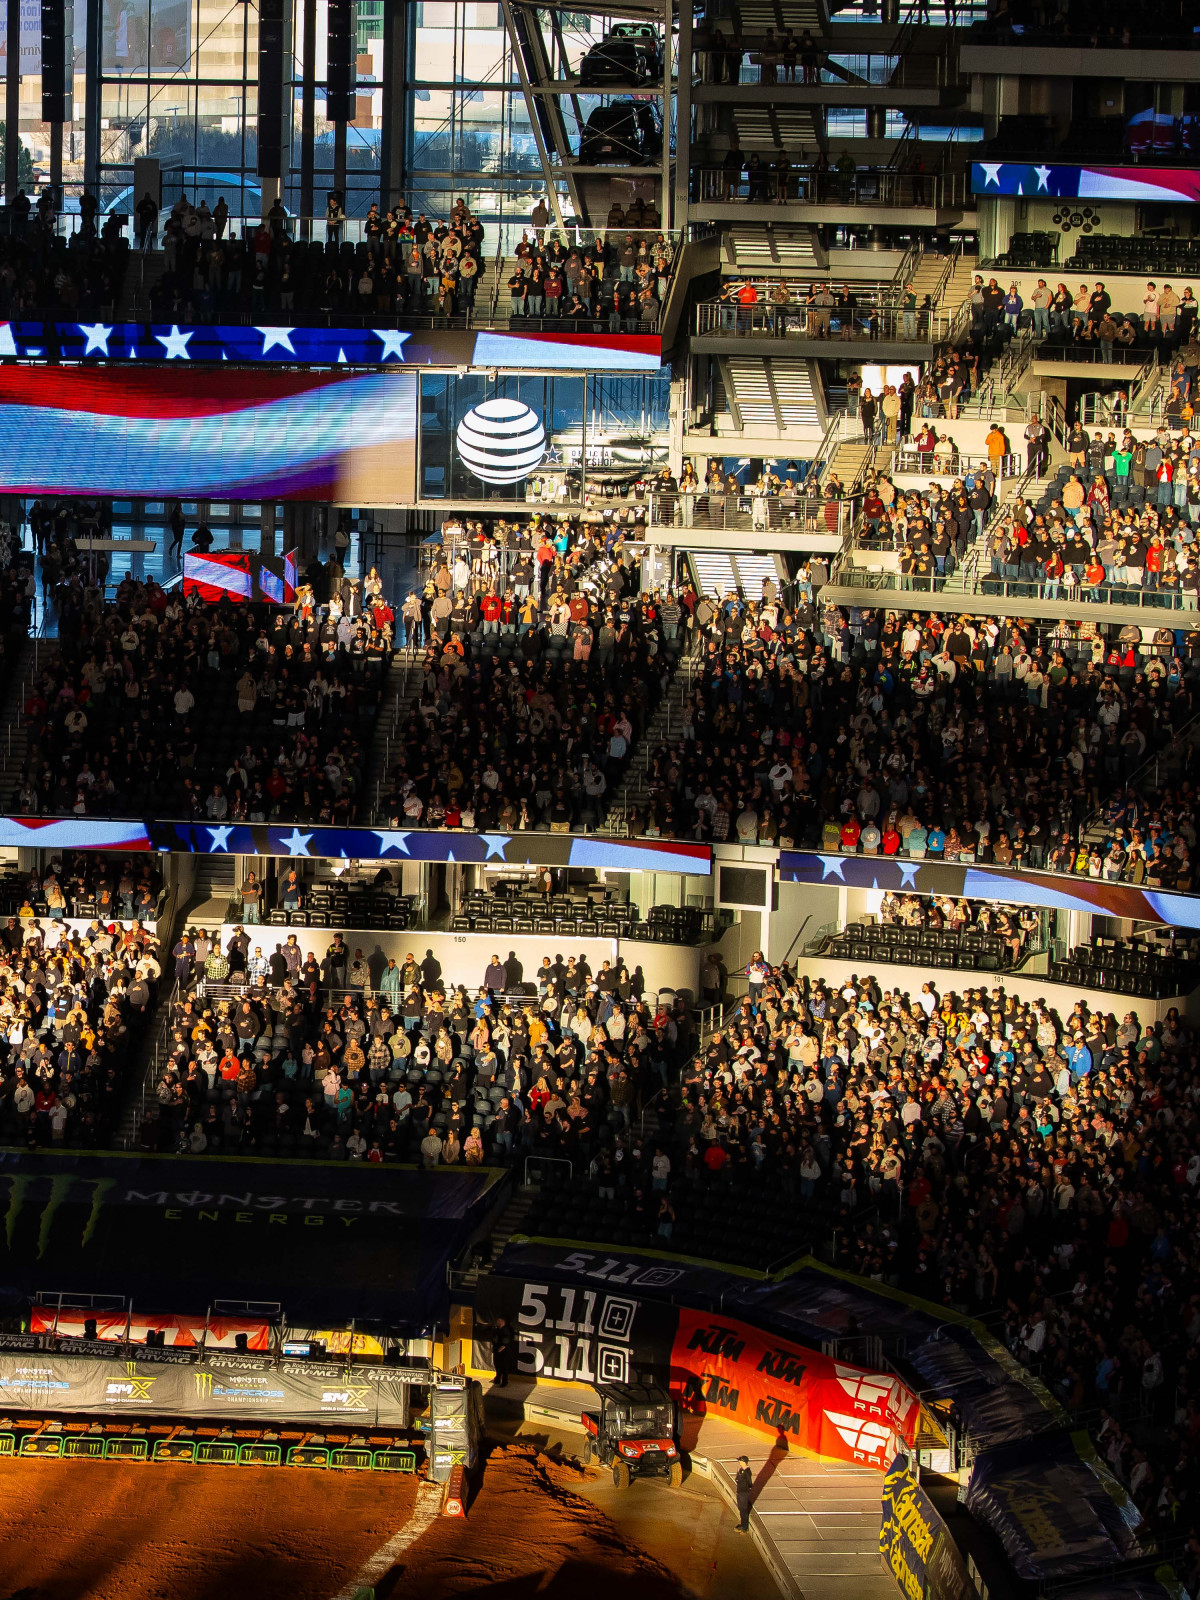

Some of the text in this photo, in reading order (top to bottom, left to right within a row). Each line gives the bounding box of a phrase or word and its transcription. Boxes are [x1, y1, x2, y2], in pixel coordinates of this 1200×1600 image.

[592, 458, 615, 466] SHOP
[993, 975, 1004, 983] 101
[124, 1188, 406, 1216] MONSTER
[163, 1208, 359, 1229] ENERGY
[554, 1252, 640, 1284] 5.11
[518, 1283, 597, 1334] 5.11
[517, 1331, 595, 1382] 5.11
[687, 1324, 746, 1362] KTM
[15, 1367, 54, 1376] MONSTER
[229, 1375, 268, 1384] MONSTER
[756, 1348, 807, 1386] KTM
[105, 1380, 154, 1399] SMX
[321, 1389, 369, 1408] SMX
[682, 1372, 739, 1411] KTM
[755, 1395, 800, 1435] KTM
[854, 1401, 902, 1432] RACNG
[853, 1450, 891, 1470] RAC
